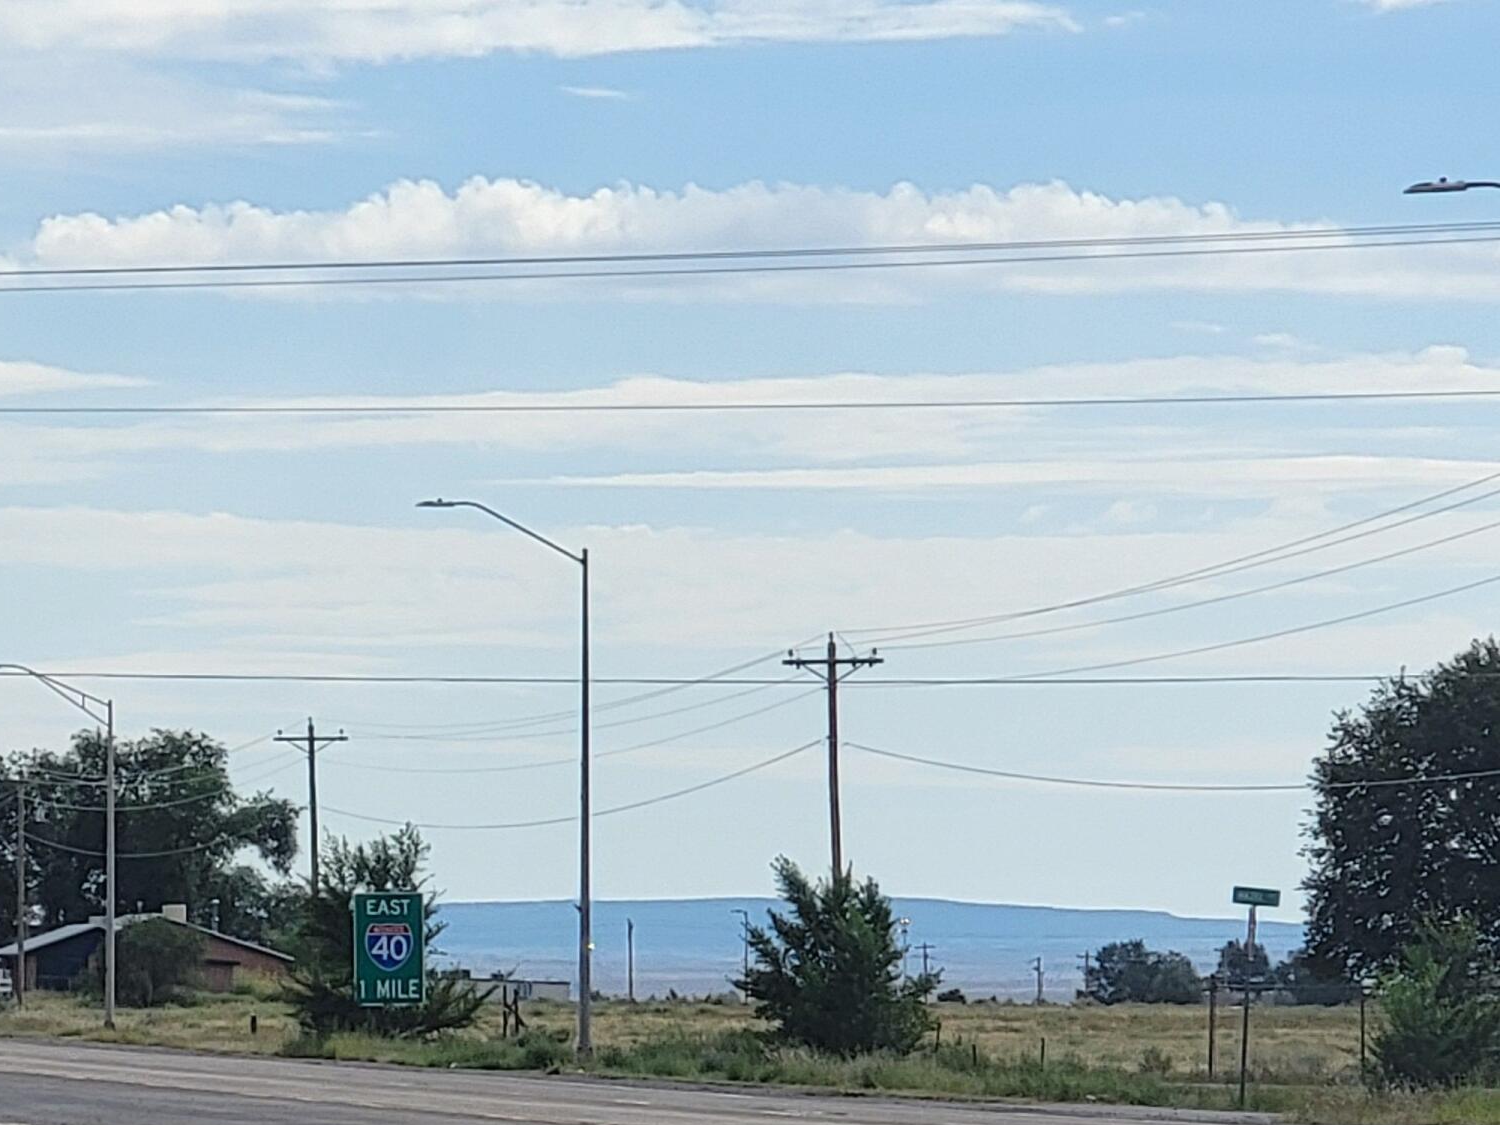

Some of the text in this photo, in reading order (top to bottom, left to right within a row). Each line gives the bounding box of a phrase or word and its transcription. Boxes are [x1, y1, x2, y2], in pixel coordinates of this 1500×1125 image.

[366, 899, 411, 916] EAST
[372, 935, 408, 961] 40
[360, 979, 420, 999] 1 MILE
